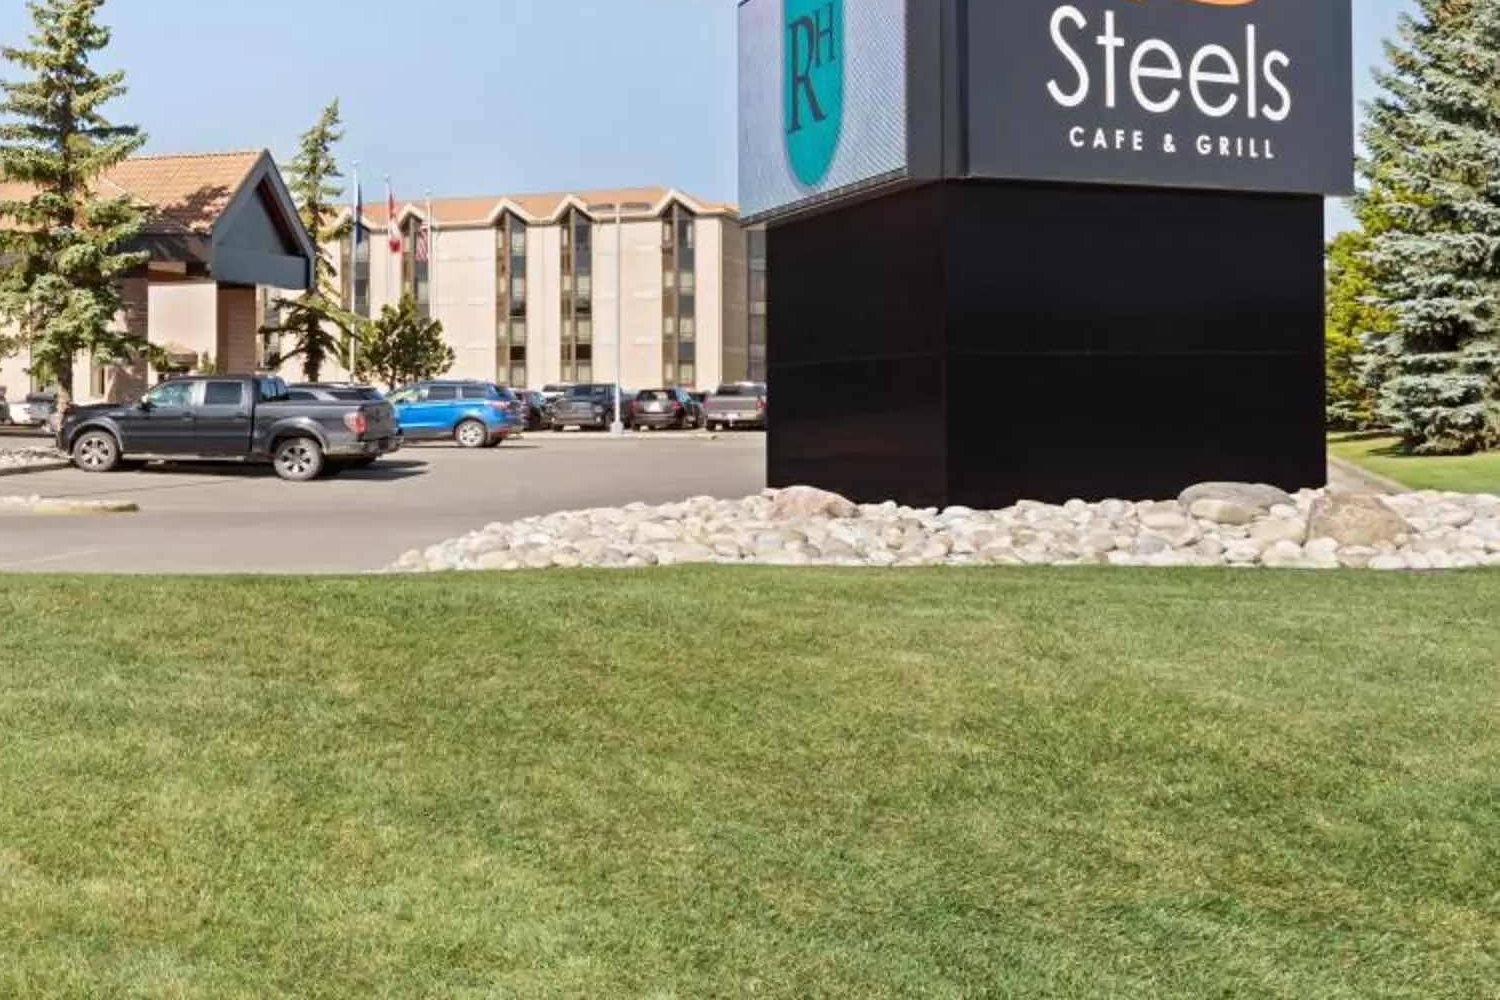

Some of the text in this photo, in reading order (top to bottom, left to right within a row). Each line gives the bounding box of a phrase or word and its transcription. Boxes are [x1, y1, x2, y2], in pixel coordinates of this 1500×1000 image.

[1046, 5, 1291, 122] Steels
[1069, 126, 1276, 159] CAFE & GRILL
